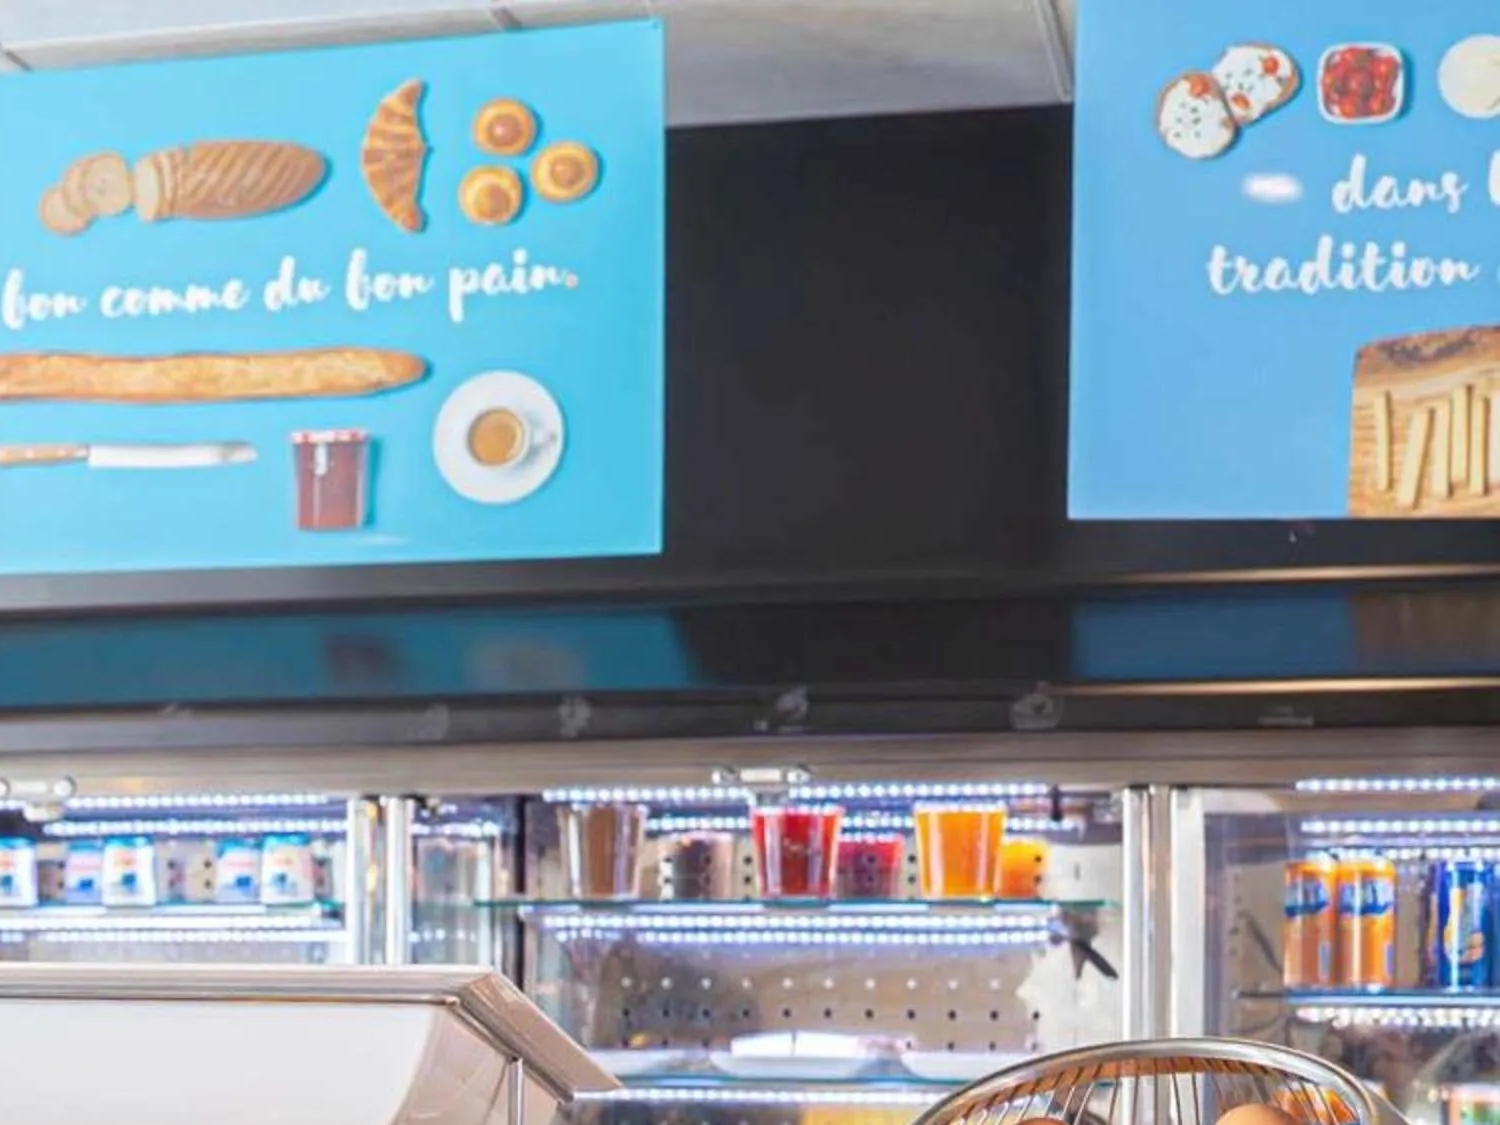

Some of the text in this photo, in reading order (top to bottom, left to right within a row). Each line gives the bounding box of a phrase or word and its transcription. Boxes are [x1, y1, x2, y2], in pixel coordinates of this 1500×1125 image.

[1331, 153, 1468, 213] dans
[0, 248, 579, 331] bon comme du bon pain.
[1207, 234, 1481, 296] tradition
